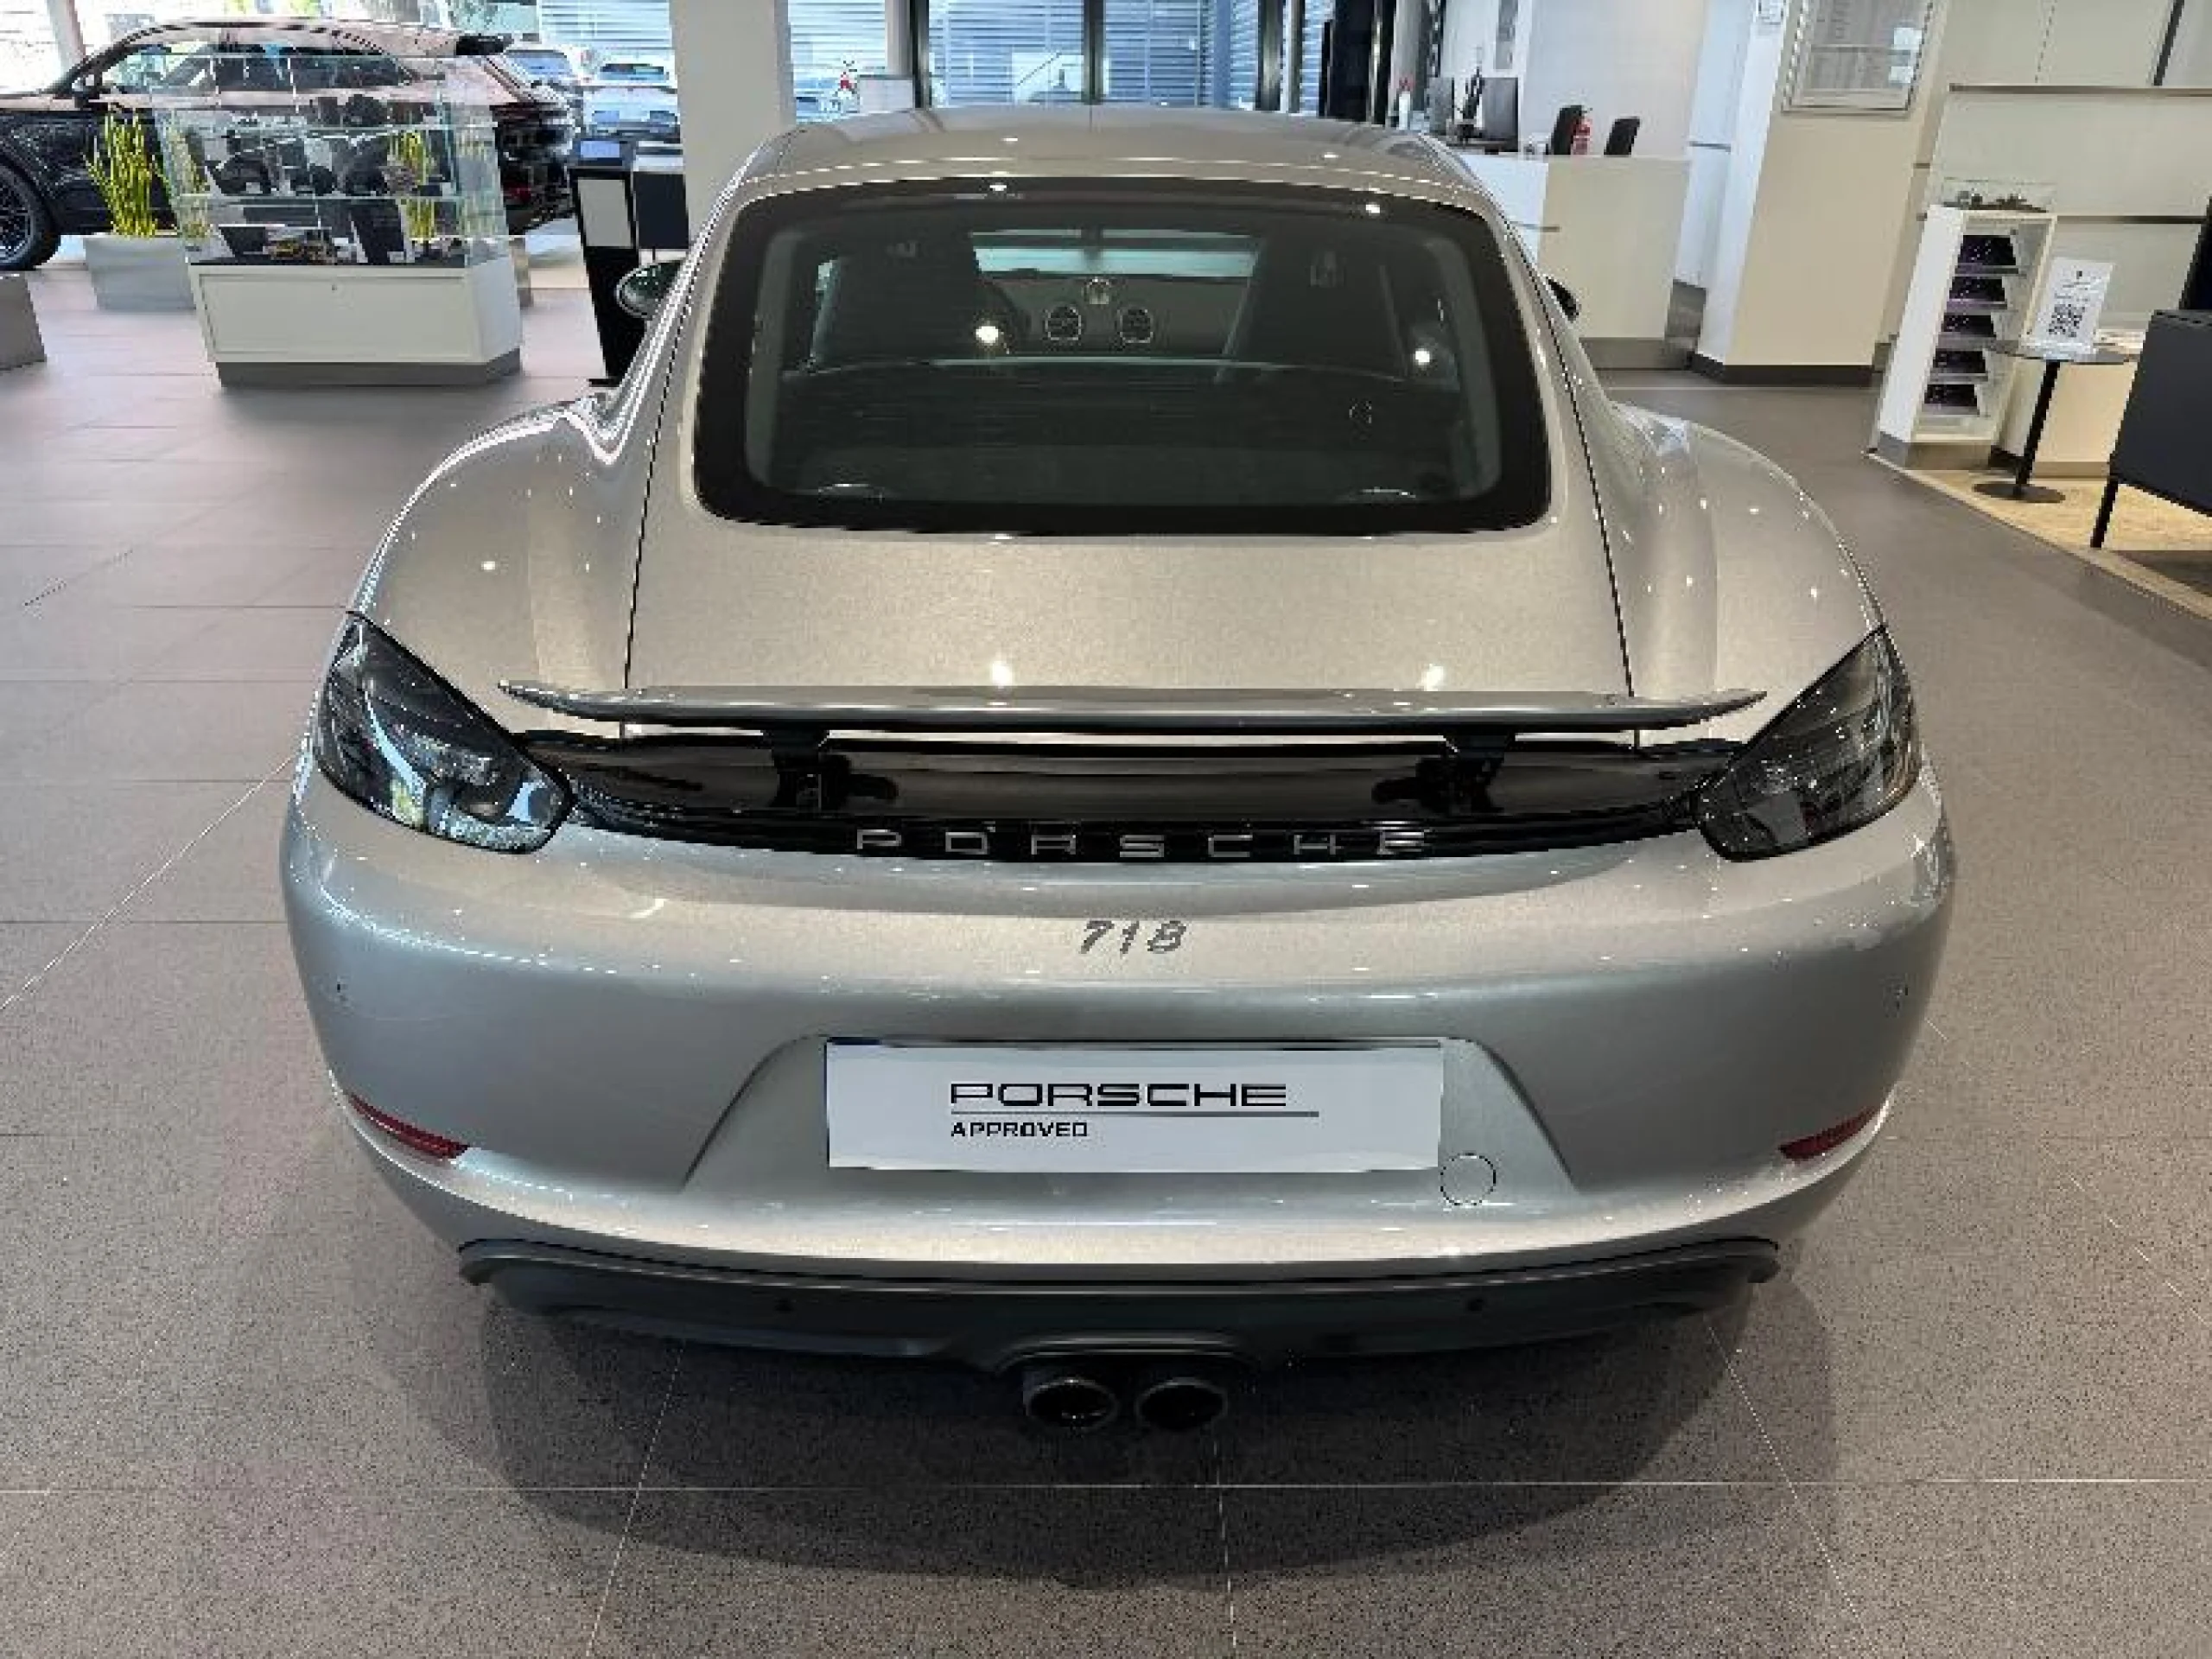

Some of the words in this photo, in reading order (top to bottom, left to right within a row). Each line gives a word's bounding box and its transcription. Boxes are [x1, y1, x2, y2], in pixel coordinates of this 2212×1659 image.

[856, 829, 1424, 858] PORSCHE
[1080, 920, 1186, 954] 718
[950, 1084, 1286, 1107] PORSCHE
[950, 1122, 1088, 1137] APPROVED
